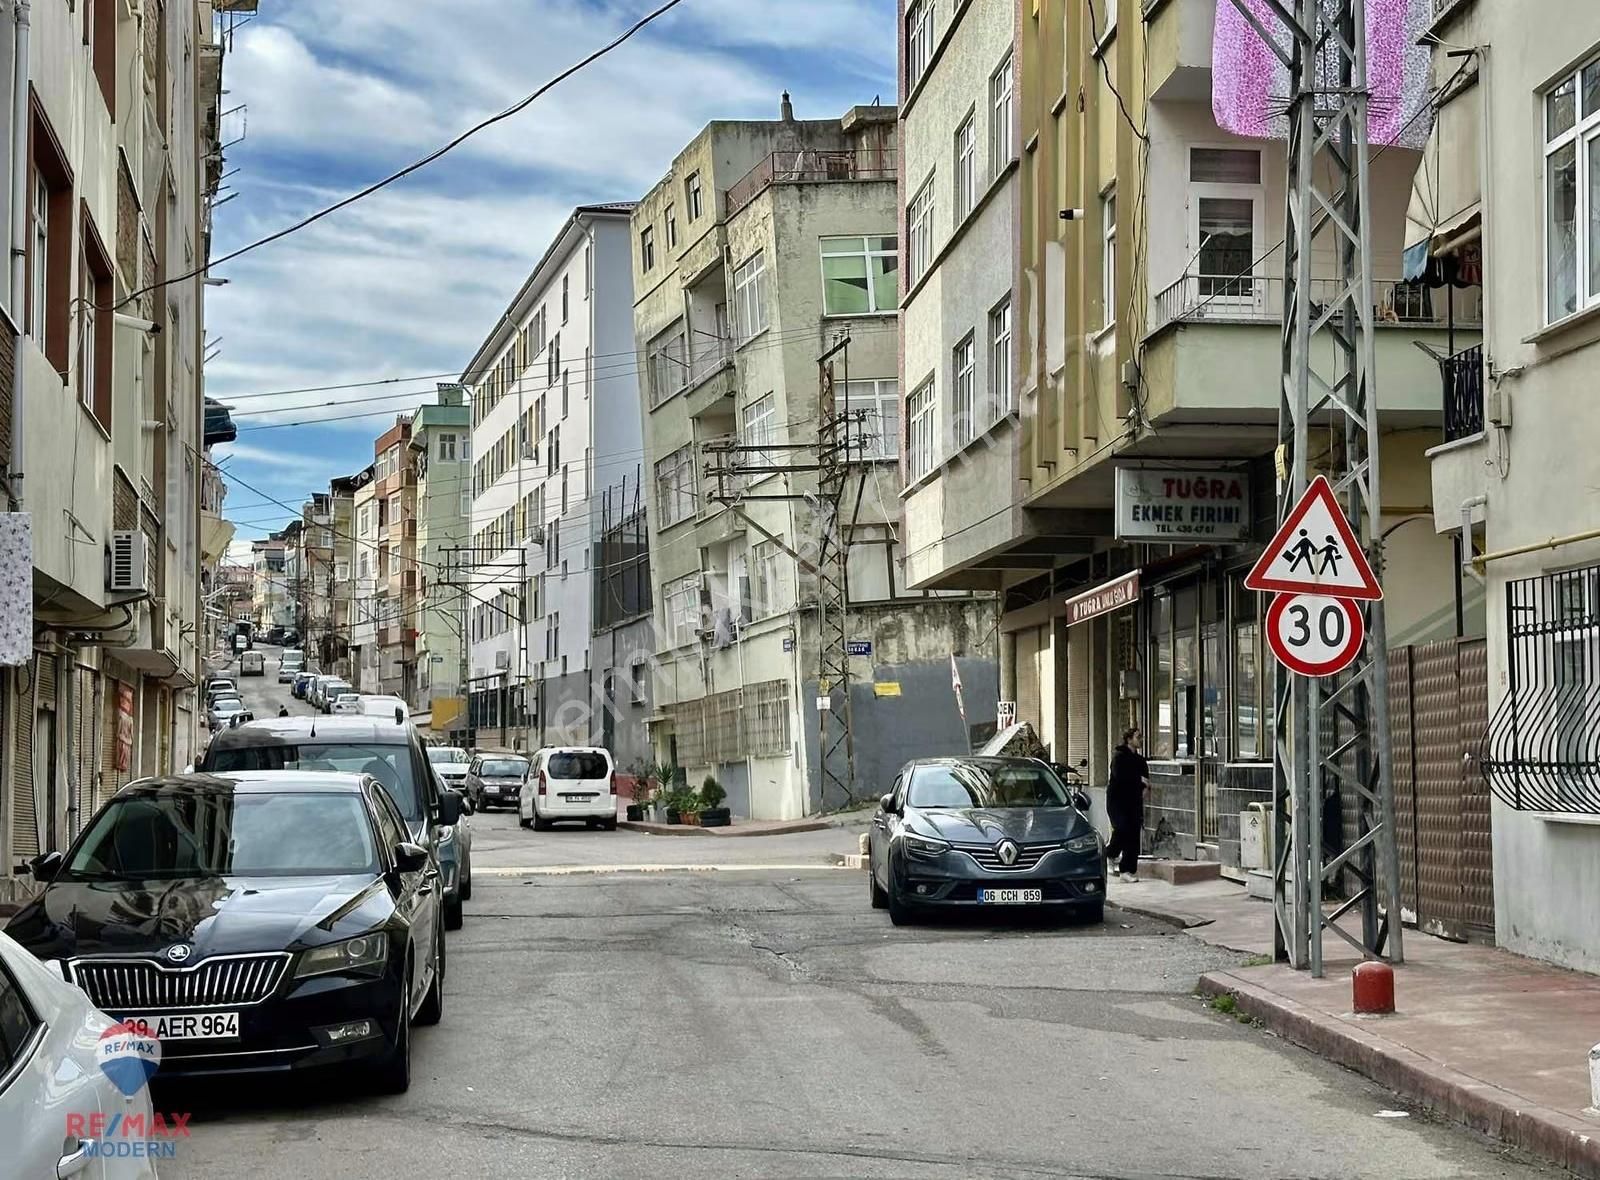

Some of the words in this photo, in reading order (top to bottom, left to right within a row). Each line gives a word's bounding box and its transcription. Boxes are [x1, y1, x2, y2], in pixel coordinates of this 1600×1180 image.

[1163, 476, 1242, 500] TUĞRA
[1132, 505, 1184, 522] EKMEK
[1190, 506, 1240, 523] FIRINI
[1287, 604, 1345, 648] 30
[984, 890, 996, 901] 06
[1001, 890, 1018, 901] CCH
[1023, 890, 1041, 901] 859
[156, 1016, 198, 1037] AER
[201, 1014, 237, 1036] 964
